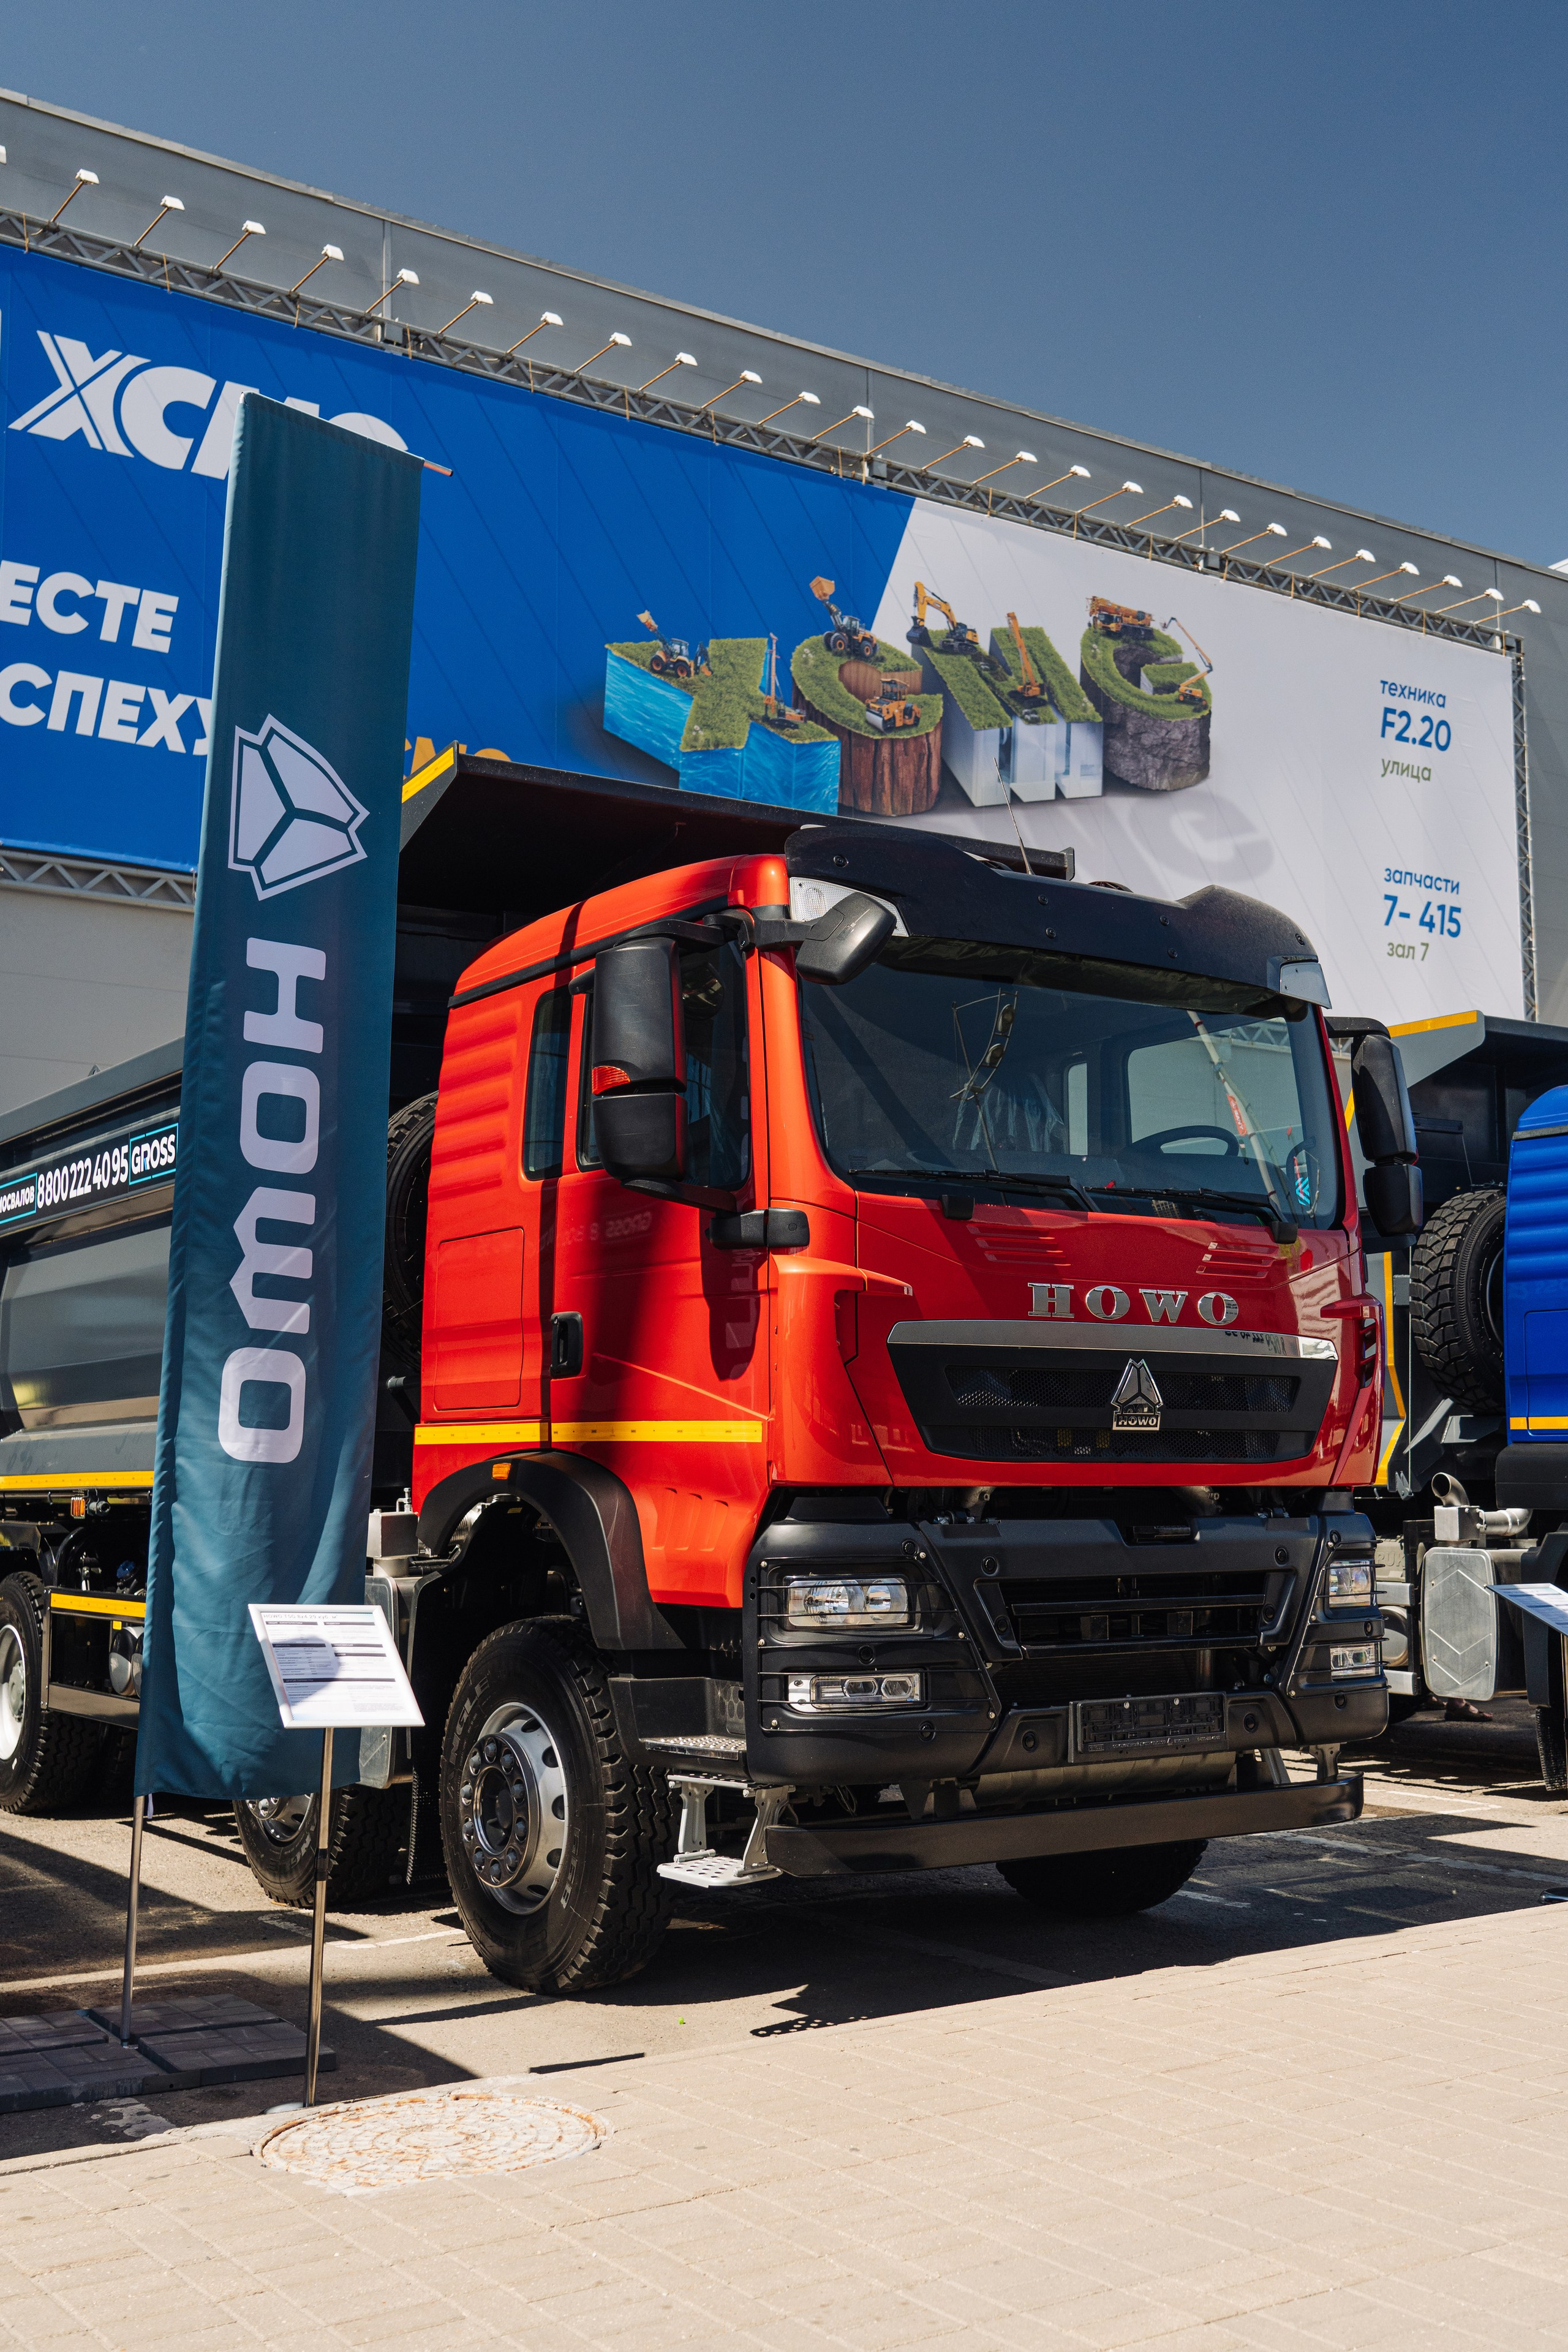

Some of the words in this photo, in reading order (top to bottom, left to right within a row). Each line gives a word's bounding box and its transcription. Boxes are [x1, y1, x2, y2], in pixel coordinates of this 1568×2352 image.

[1380, 680, 1447, 709] техника
[1381, 707, 1452, 752] F2.20
[1381, 758, 1431, 783] улица
[1384, 867, 1460, 895] запчасти
[1387, 942, 1415, 960] зал
[1420, 943, 1430, 962] 7
[131, 1134, 176, 1175] GROSS
[0, 1185, 35, 1213] ОСВАЛОВ
[217, 937, 326, 1464] HOWO
[1028, 1282, 1239, 1325] HOWO
[1118, 1415, 1157, 1427] HOWO
